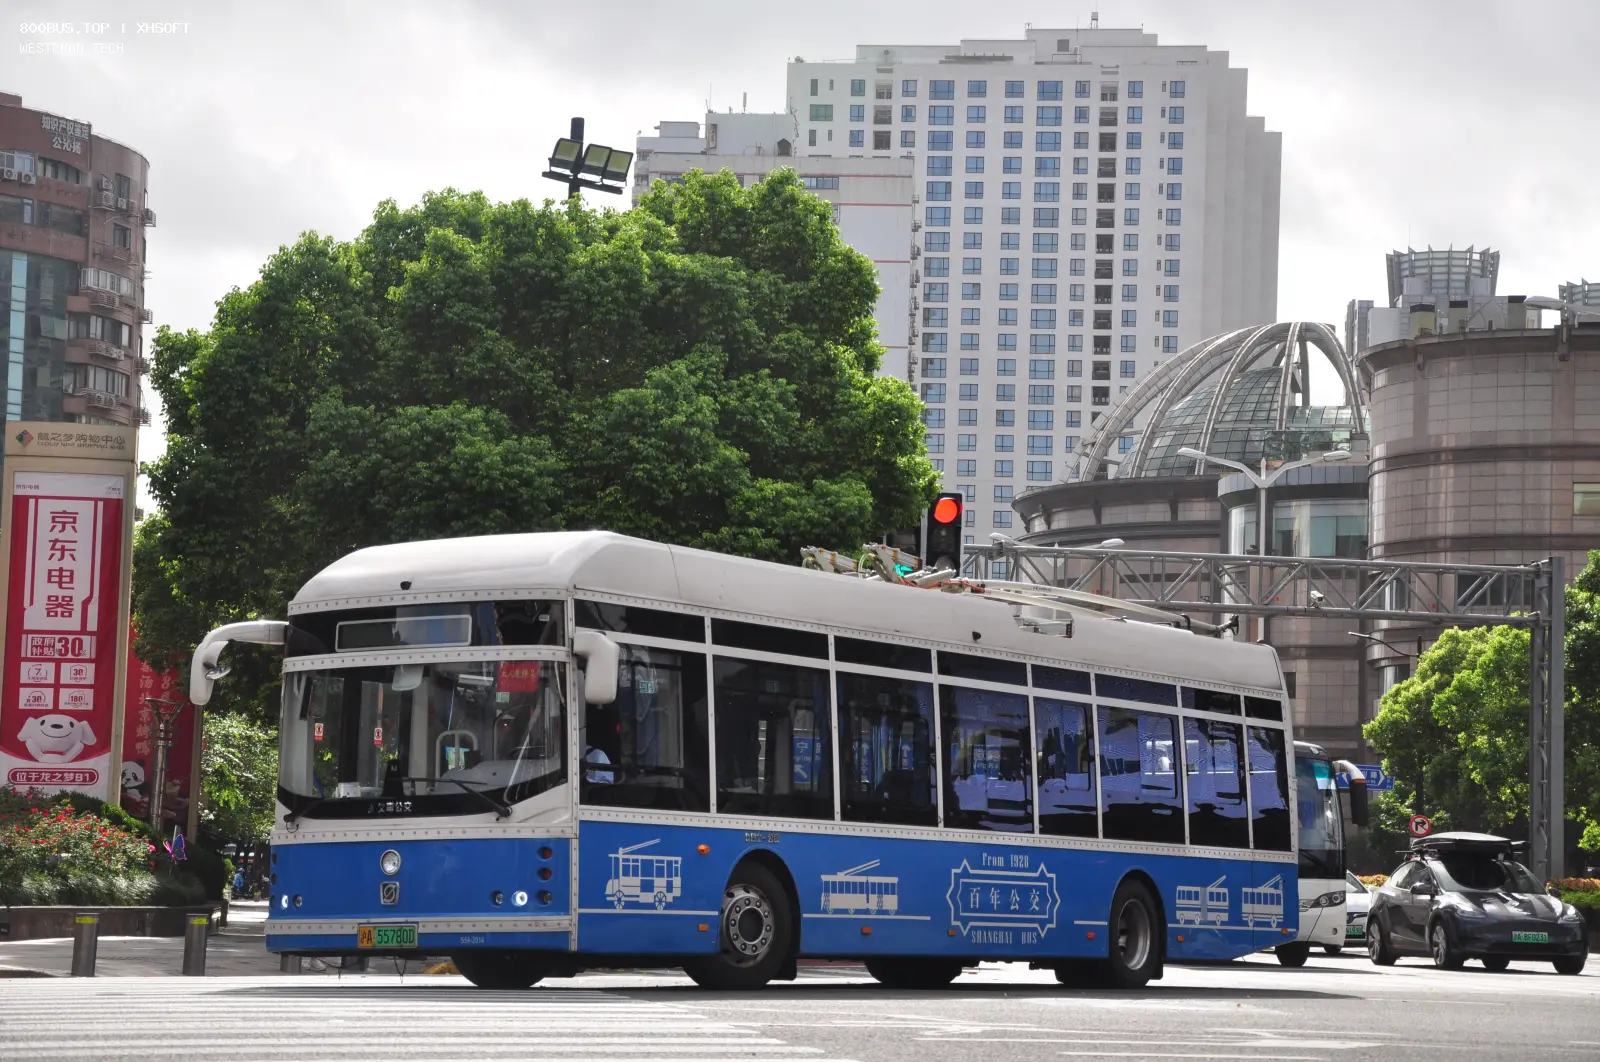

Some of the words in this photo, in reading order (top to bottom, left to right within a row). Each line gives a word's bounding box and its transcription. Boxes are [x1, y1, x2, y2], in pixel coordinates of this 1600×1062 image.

[41, 115, 90, 140] 知识产权鉴定
[45, 509, 79, 618] 京东电器
[16, 771, 90, 782] 位于龙之梦B1
[982, 852, 1004, 867] From
[1010, 854, 1029, 868] 1928
[969, 886, 1040, 911] 百年公交
[971, 930, 1013, 944] SHANGHAI
[1021, 932, 1037, 945] BUS
